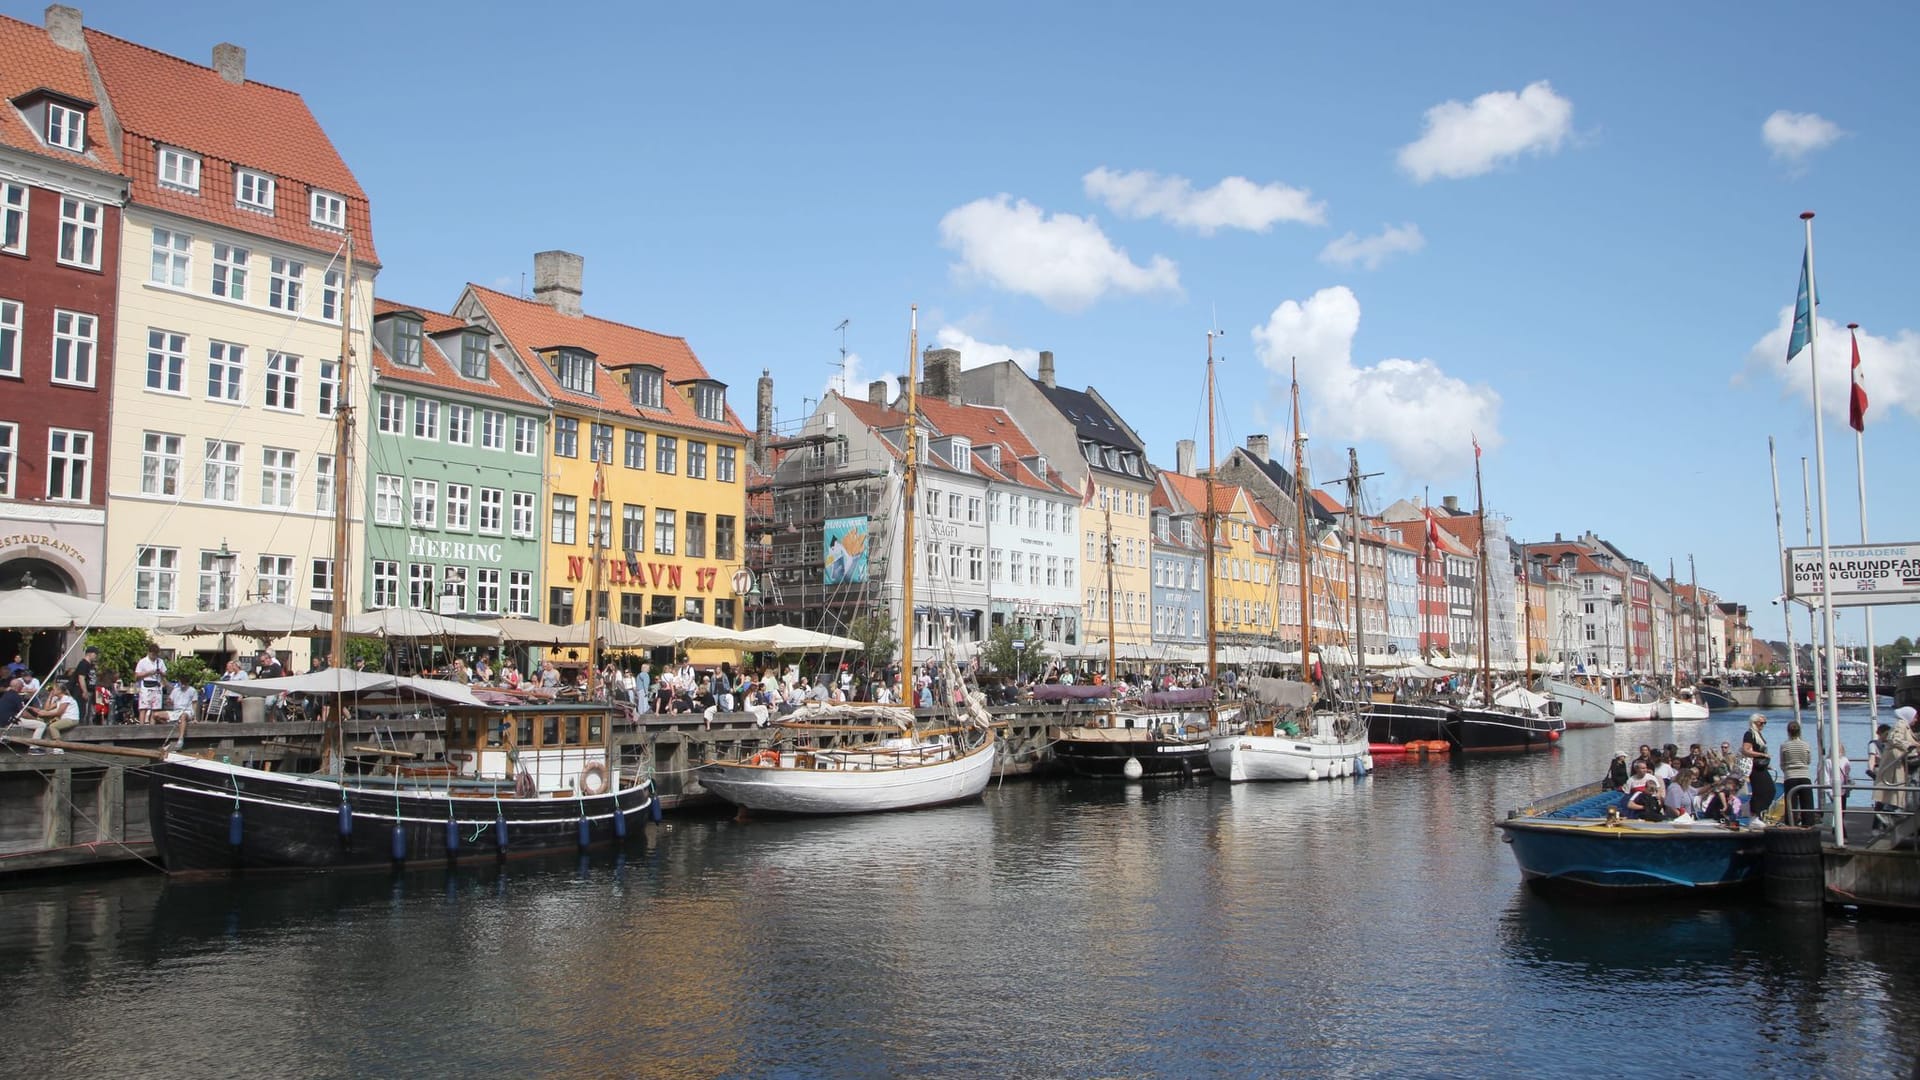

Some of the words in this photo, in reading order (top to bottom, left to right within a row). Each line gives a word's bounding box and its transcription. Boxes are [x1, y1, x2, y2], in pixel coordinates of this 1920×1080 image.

[408, 535, 502, 562] HEERING
[1817, 548, 1907, 558] NTTO-BADENE
[695, 567, 717, 592] 17
[733, 573, 747, 593] 17
[1795, 573, 1810, 581] 60
[1812, 572, 1836, 581] MN
[1840, 570, 1889, 579] GUIDED
